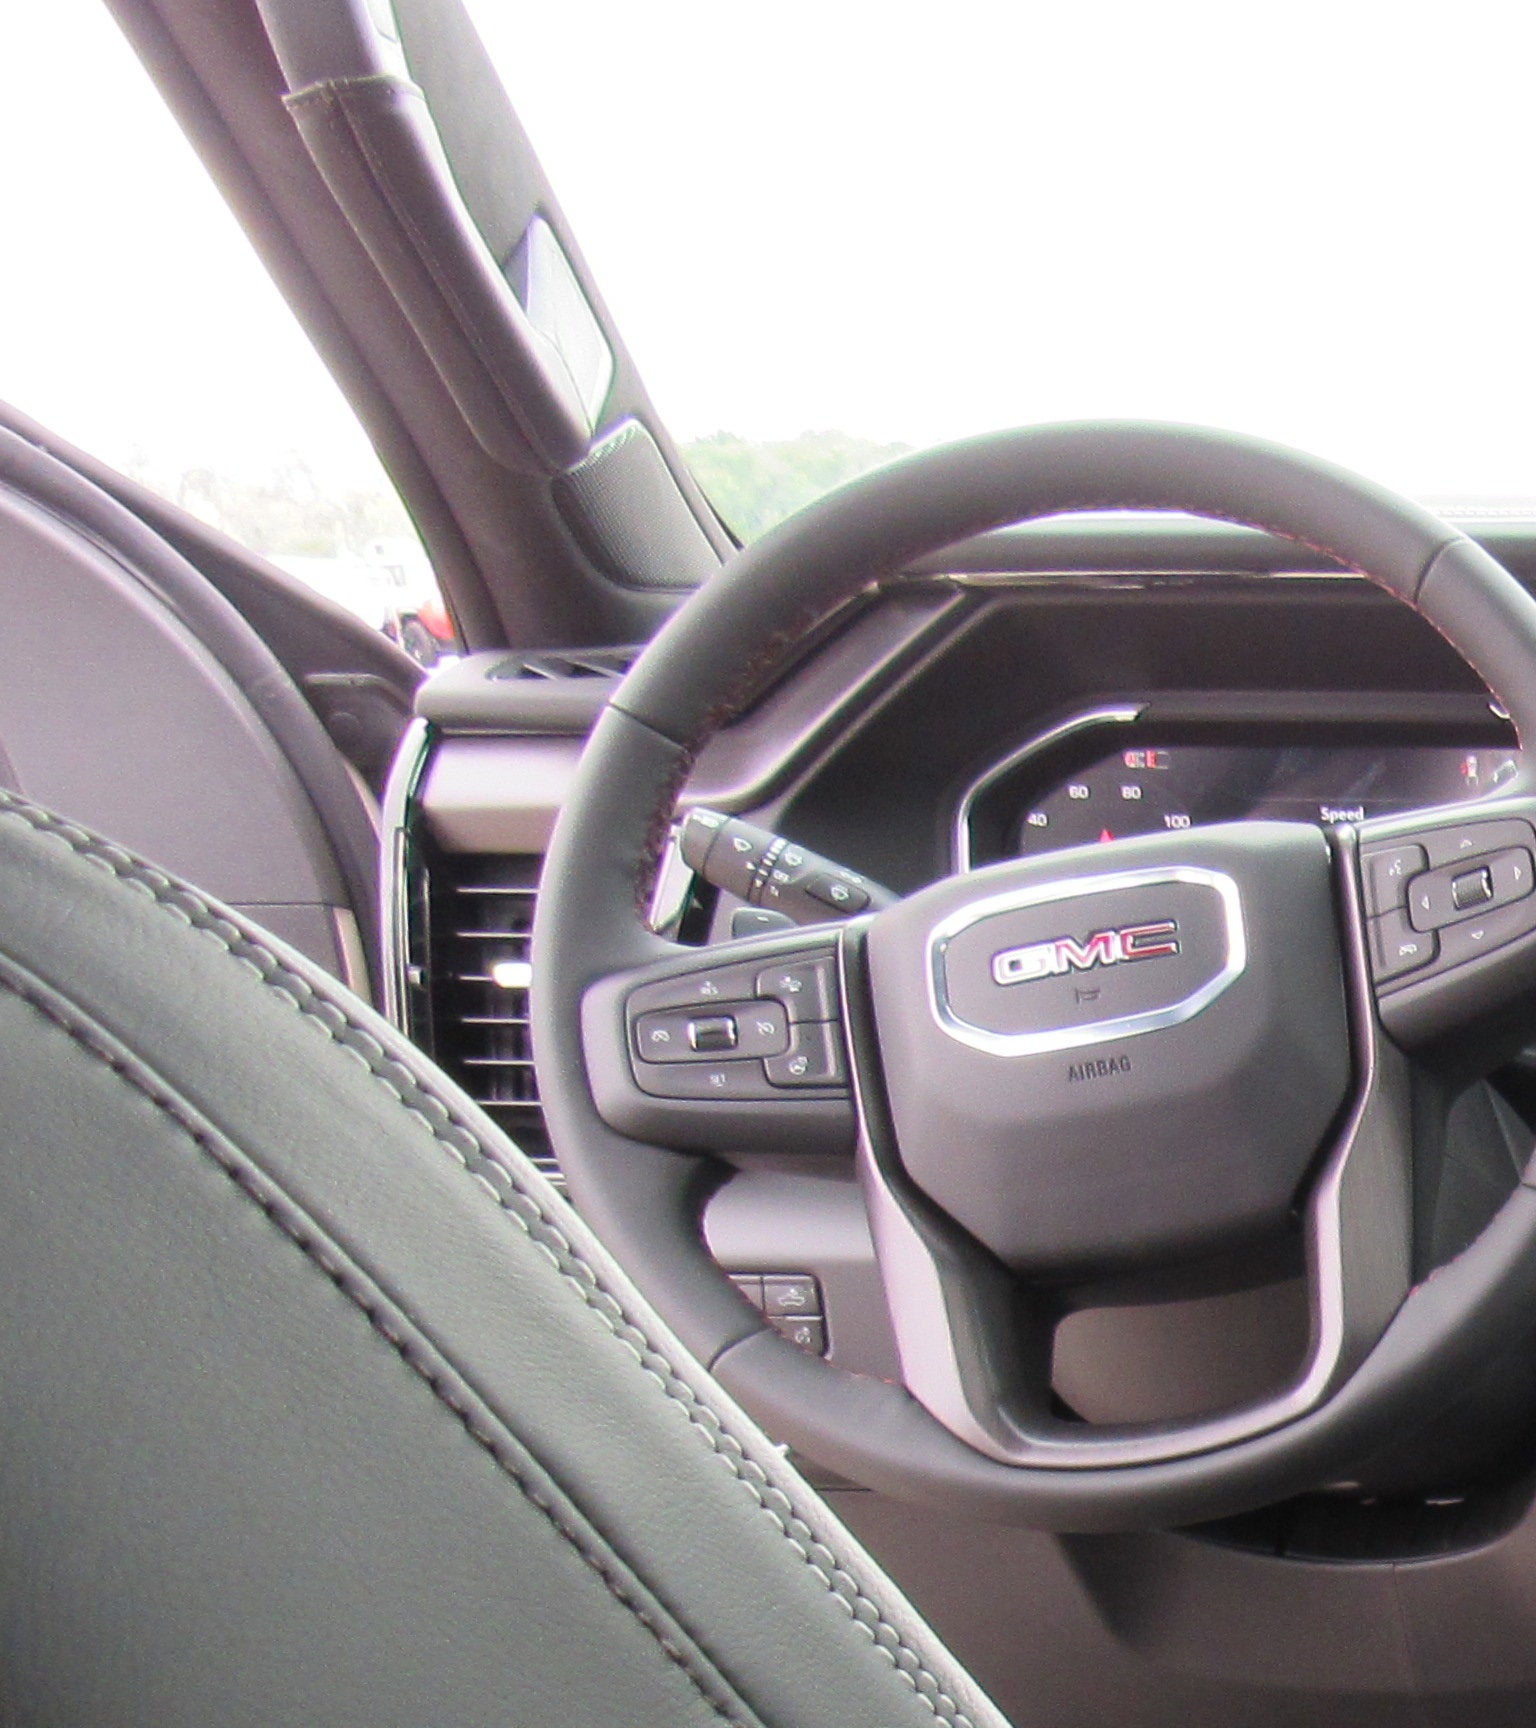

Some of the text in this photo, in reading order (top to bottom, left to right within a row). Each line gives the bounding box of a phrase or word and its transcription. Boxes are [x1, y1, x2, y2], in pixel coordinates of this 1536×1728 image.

[1027, 812, 1048, 827] 40
[1164, 814, 1191, 829] 100
[1319, 805, 1364, 824] Speed
[992, 919, 1181, 986] GMC
[1067, 1055, 1132, 1083] AIRBAG
